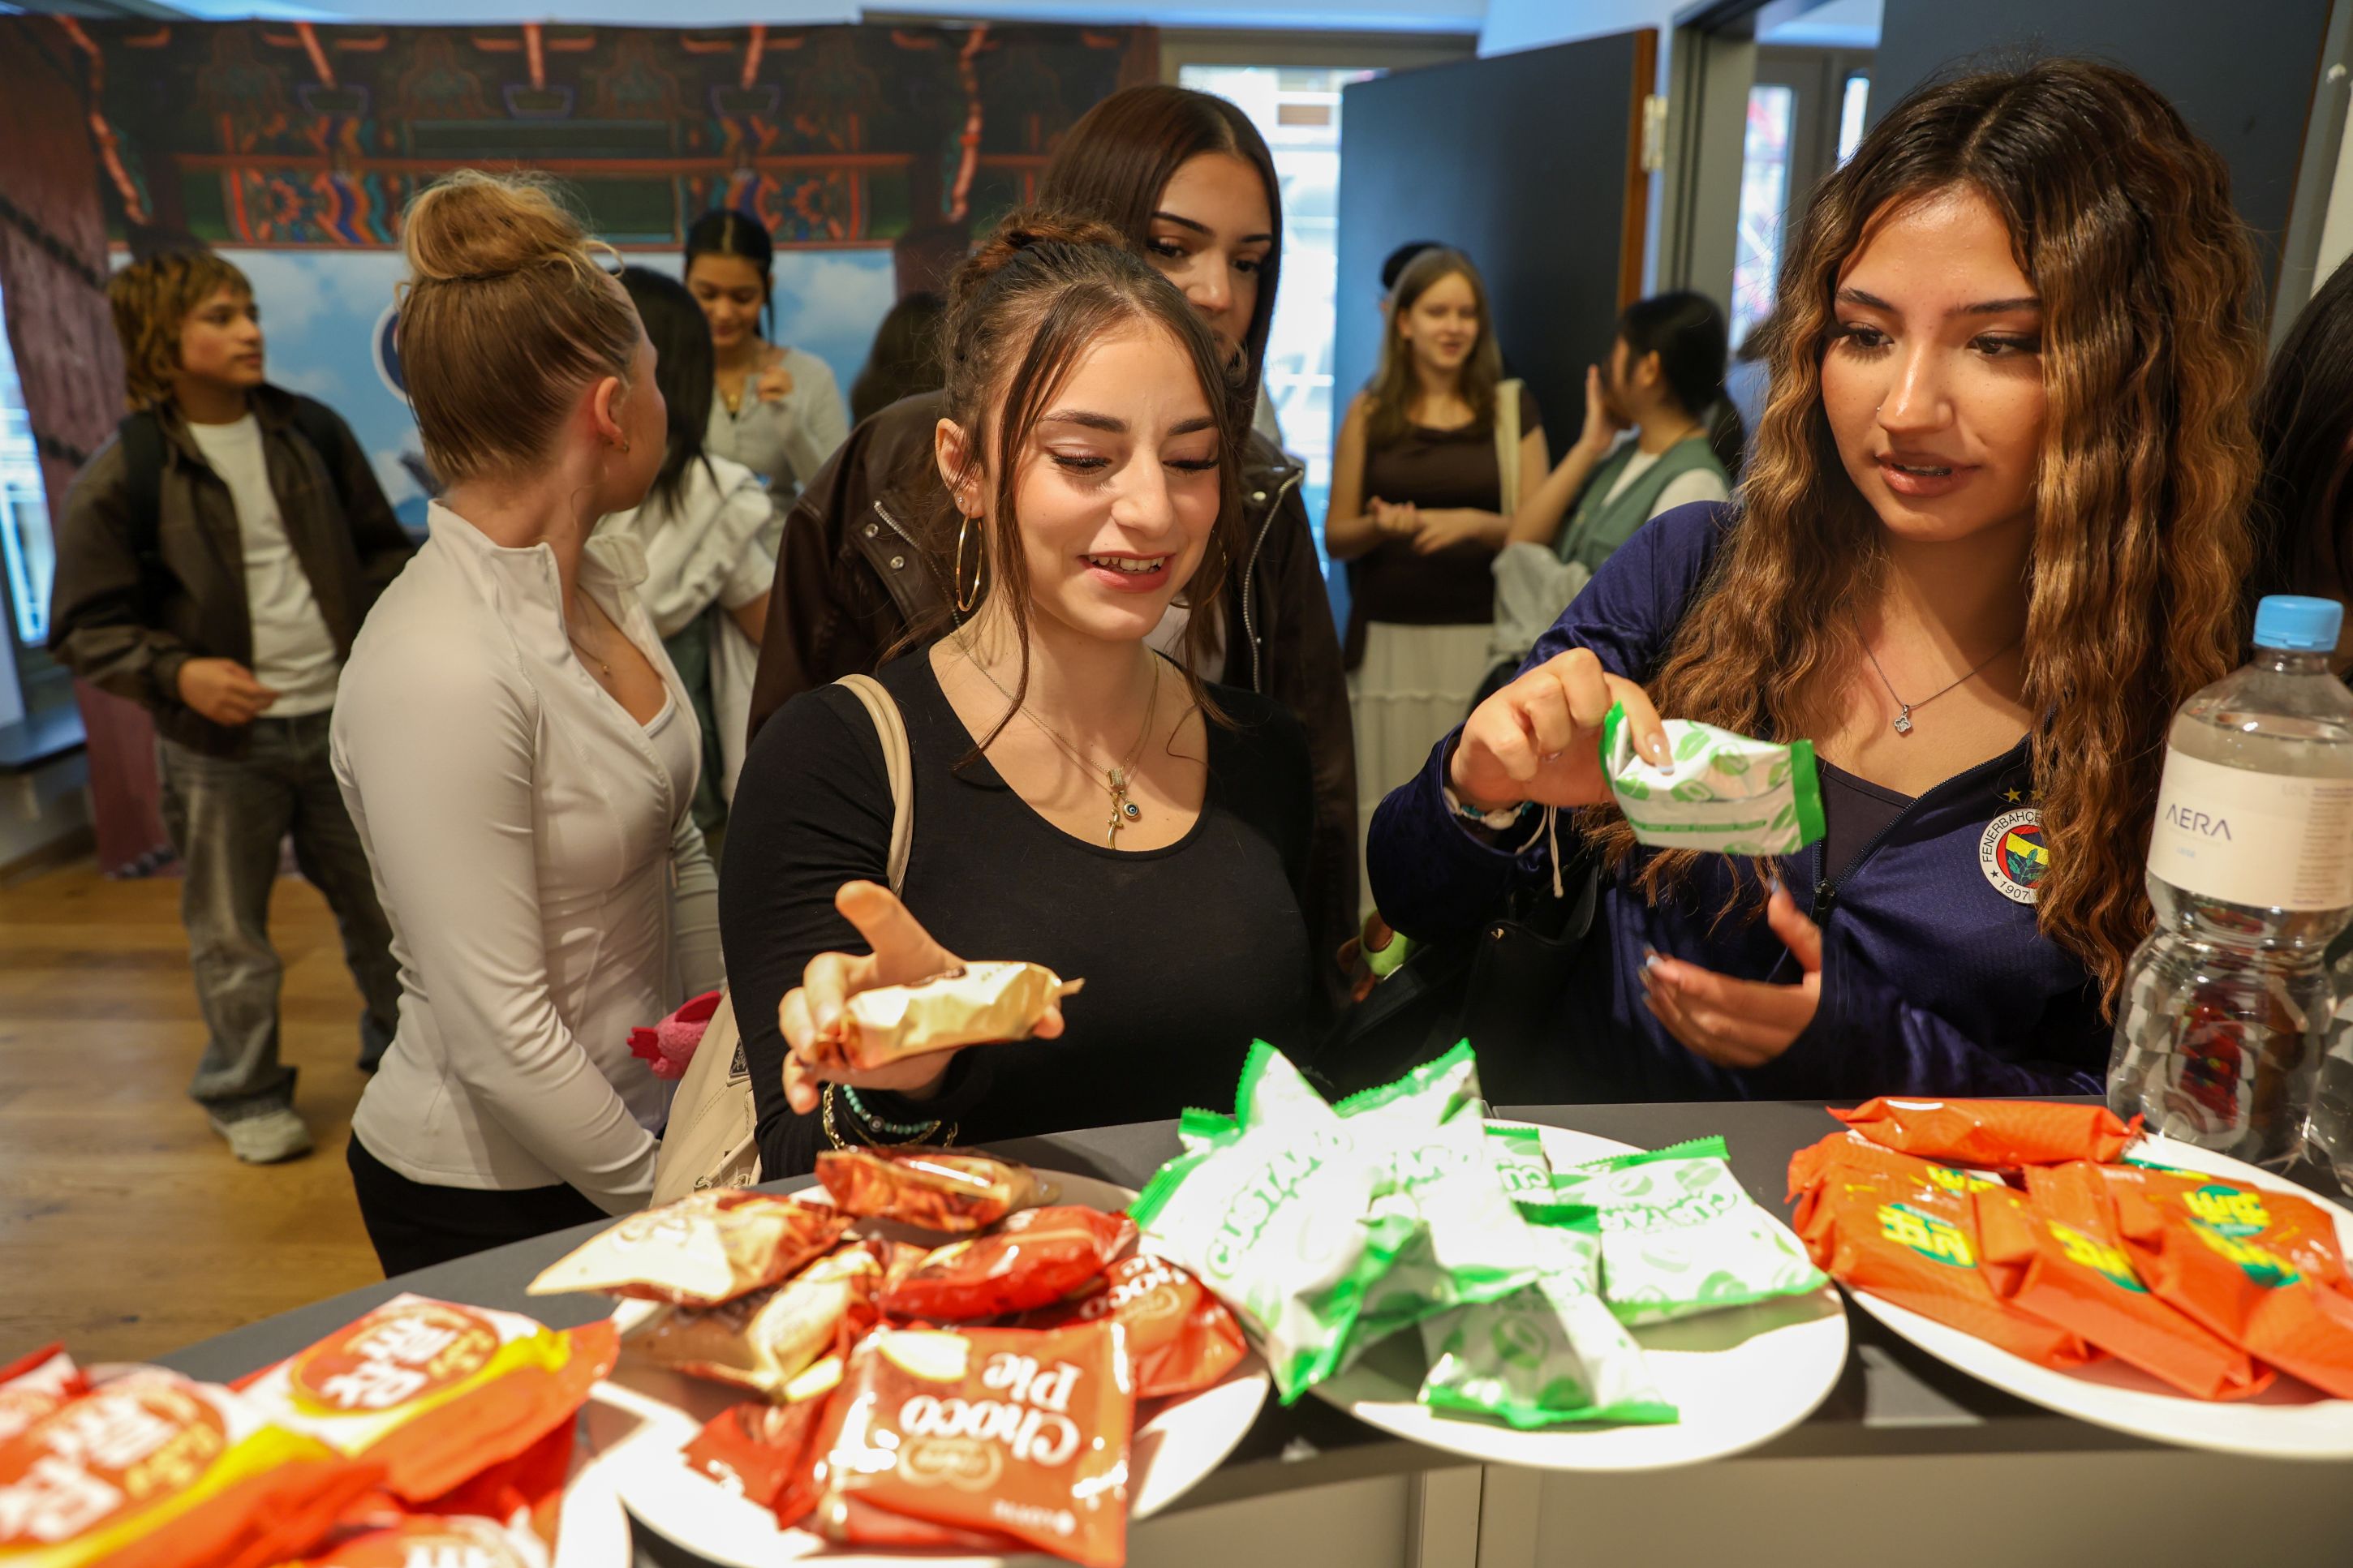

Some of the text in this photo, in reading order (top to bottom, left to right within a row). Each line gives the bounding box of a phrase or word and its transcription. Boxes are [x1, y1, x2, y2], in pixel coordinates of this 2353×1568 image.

[1999, 880, 2029, 900] 1907
[982, 1351, 1083, 1411] Pie
[898, 1393, 1082, 1468] Choco
